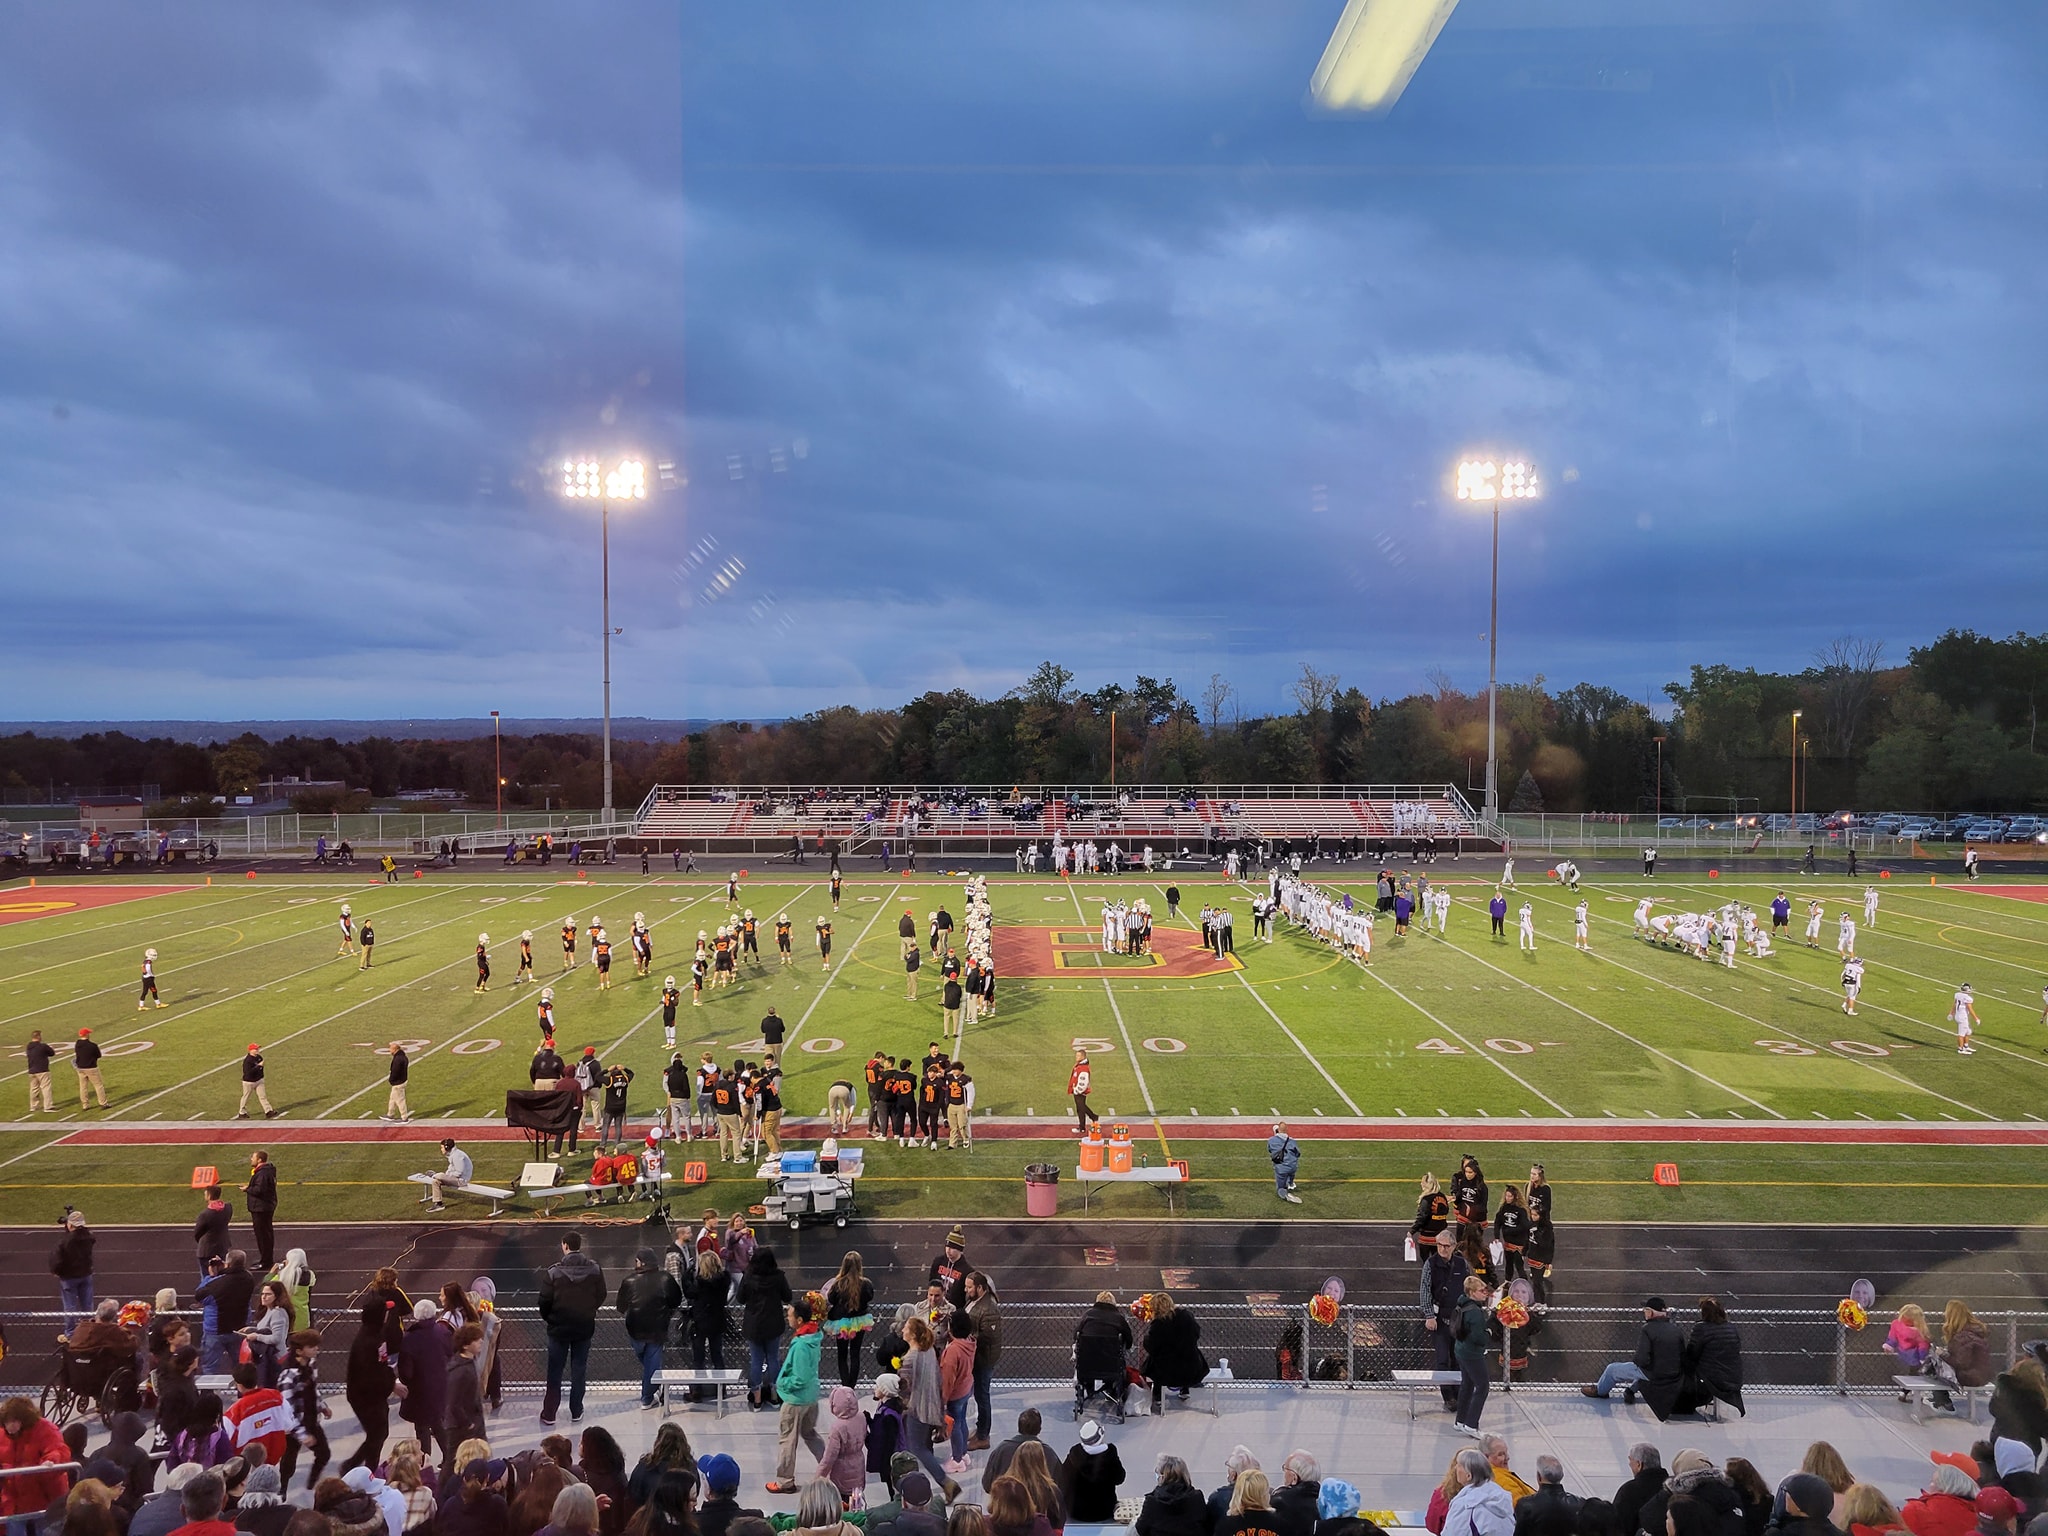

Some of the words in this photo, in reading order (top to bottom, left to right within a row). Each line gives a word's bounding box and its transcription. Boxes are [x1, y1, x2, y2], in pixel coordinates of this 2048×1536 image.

[194, 1167, 214, 1184] 30
[621, 1161, 637, 1179] 45
[686, 1163, 705, 1181] 40
[1661, 1167, 1678, 1183] 40
